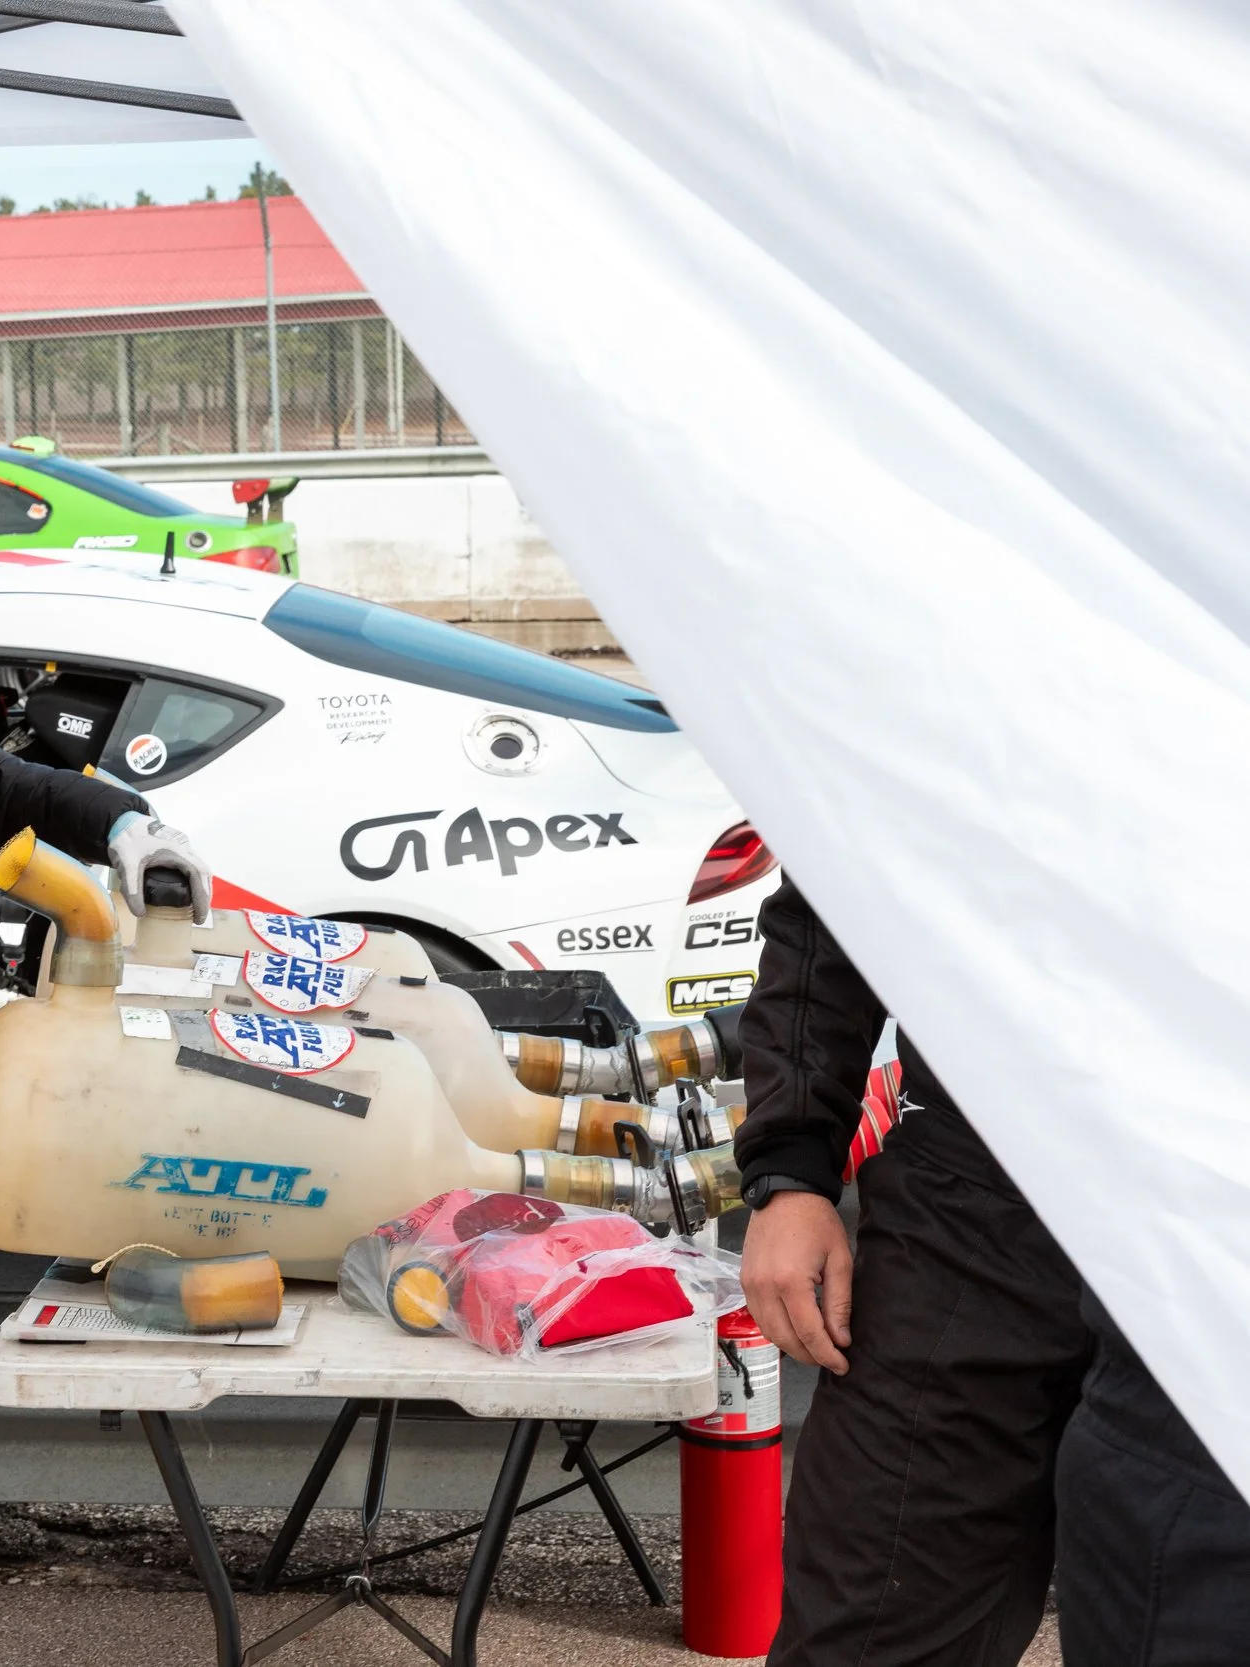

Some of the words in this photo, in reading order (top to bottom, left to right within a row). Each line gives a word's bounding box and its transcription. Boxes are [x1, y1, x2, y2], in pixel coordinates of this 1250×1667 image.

[318, 694, 393, 710] TOYOTA
[329, 710, 377, 720] RESEARCH
[57, 717, 93, 736] OMP
[326, 718, 393, 730] DEVELOPMENT
[445, 806, 640, 877] Apex
[689, 912, 724, 922] COOLED
[557, 924, 654, 952] essex
[672, 976, 754, 1005] MCS
